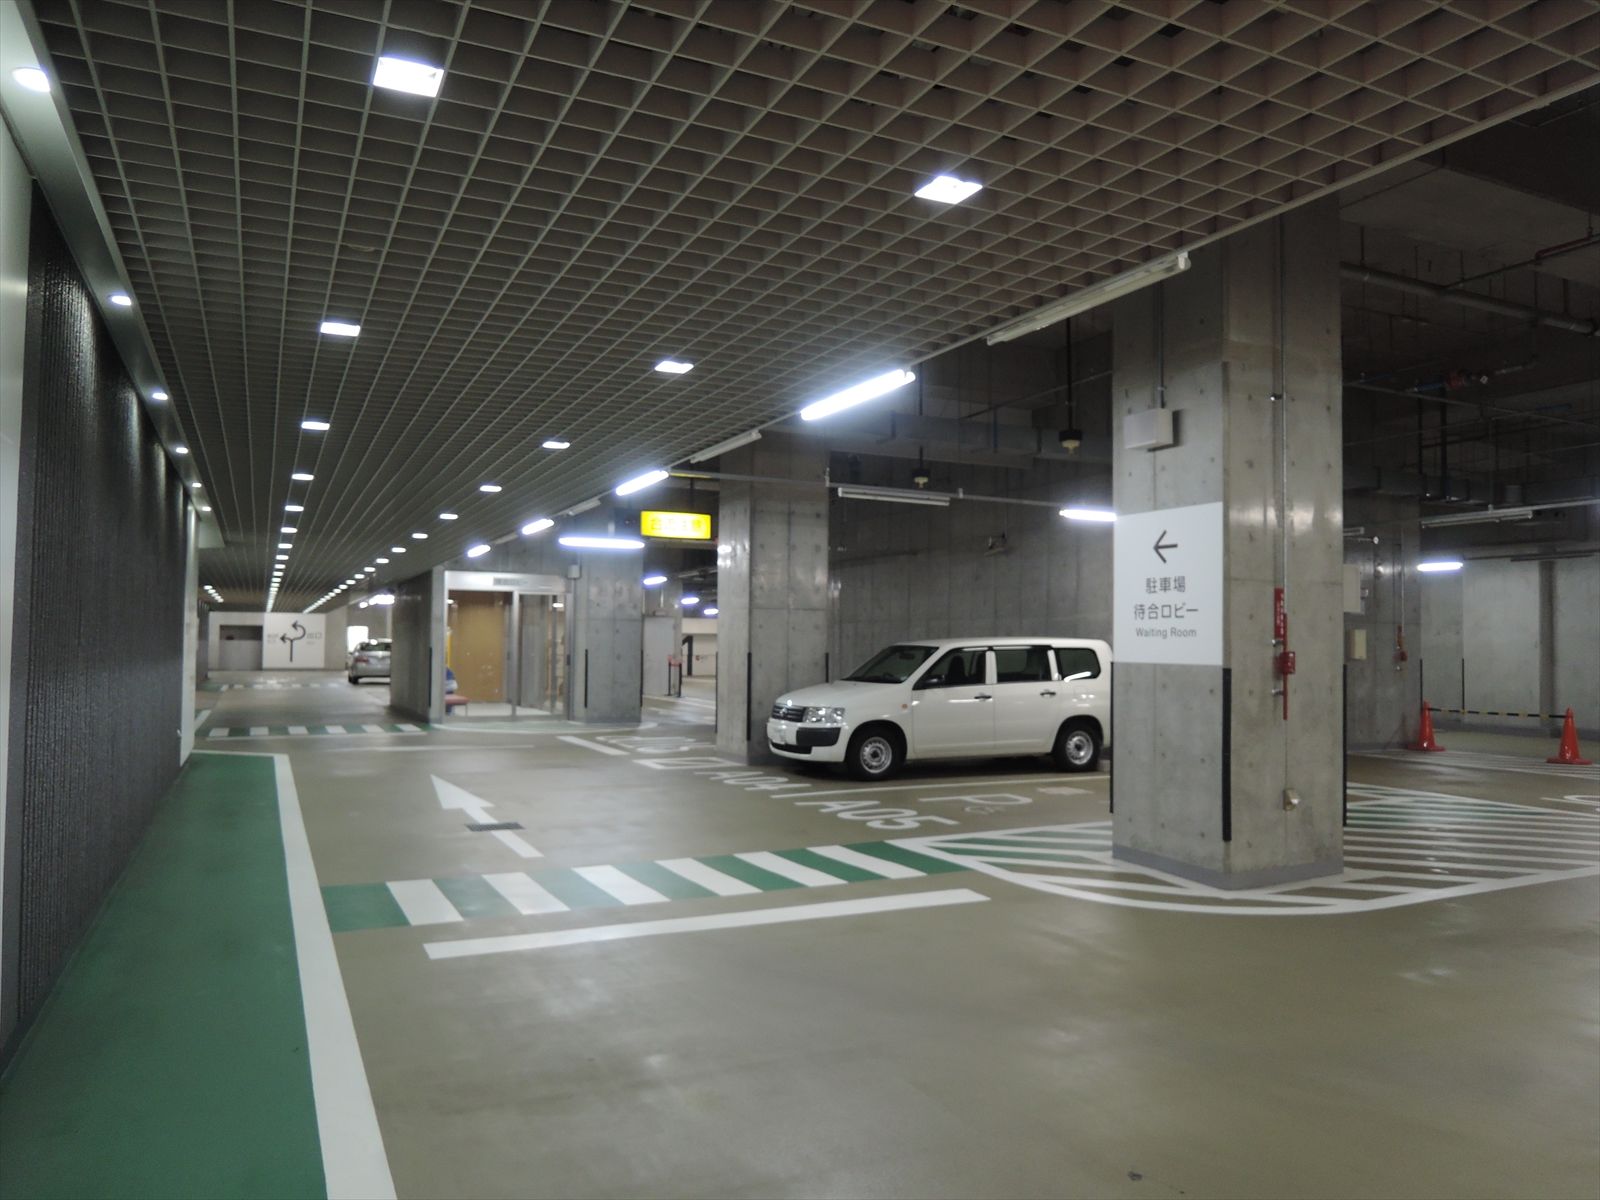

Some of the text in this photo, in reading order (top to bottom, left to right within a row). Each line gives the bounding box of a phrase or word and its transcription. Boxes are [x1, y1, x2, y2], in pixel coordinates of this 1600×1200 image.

[1145, 576, 1186, 594] 駐車場
[1134, 602, 1199, 620] 待合ロビー
[1136, 627, 1197, 639] Waiting Room
[794, 800, 960, 830] A05
